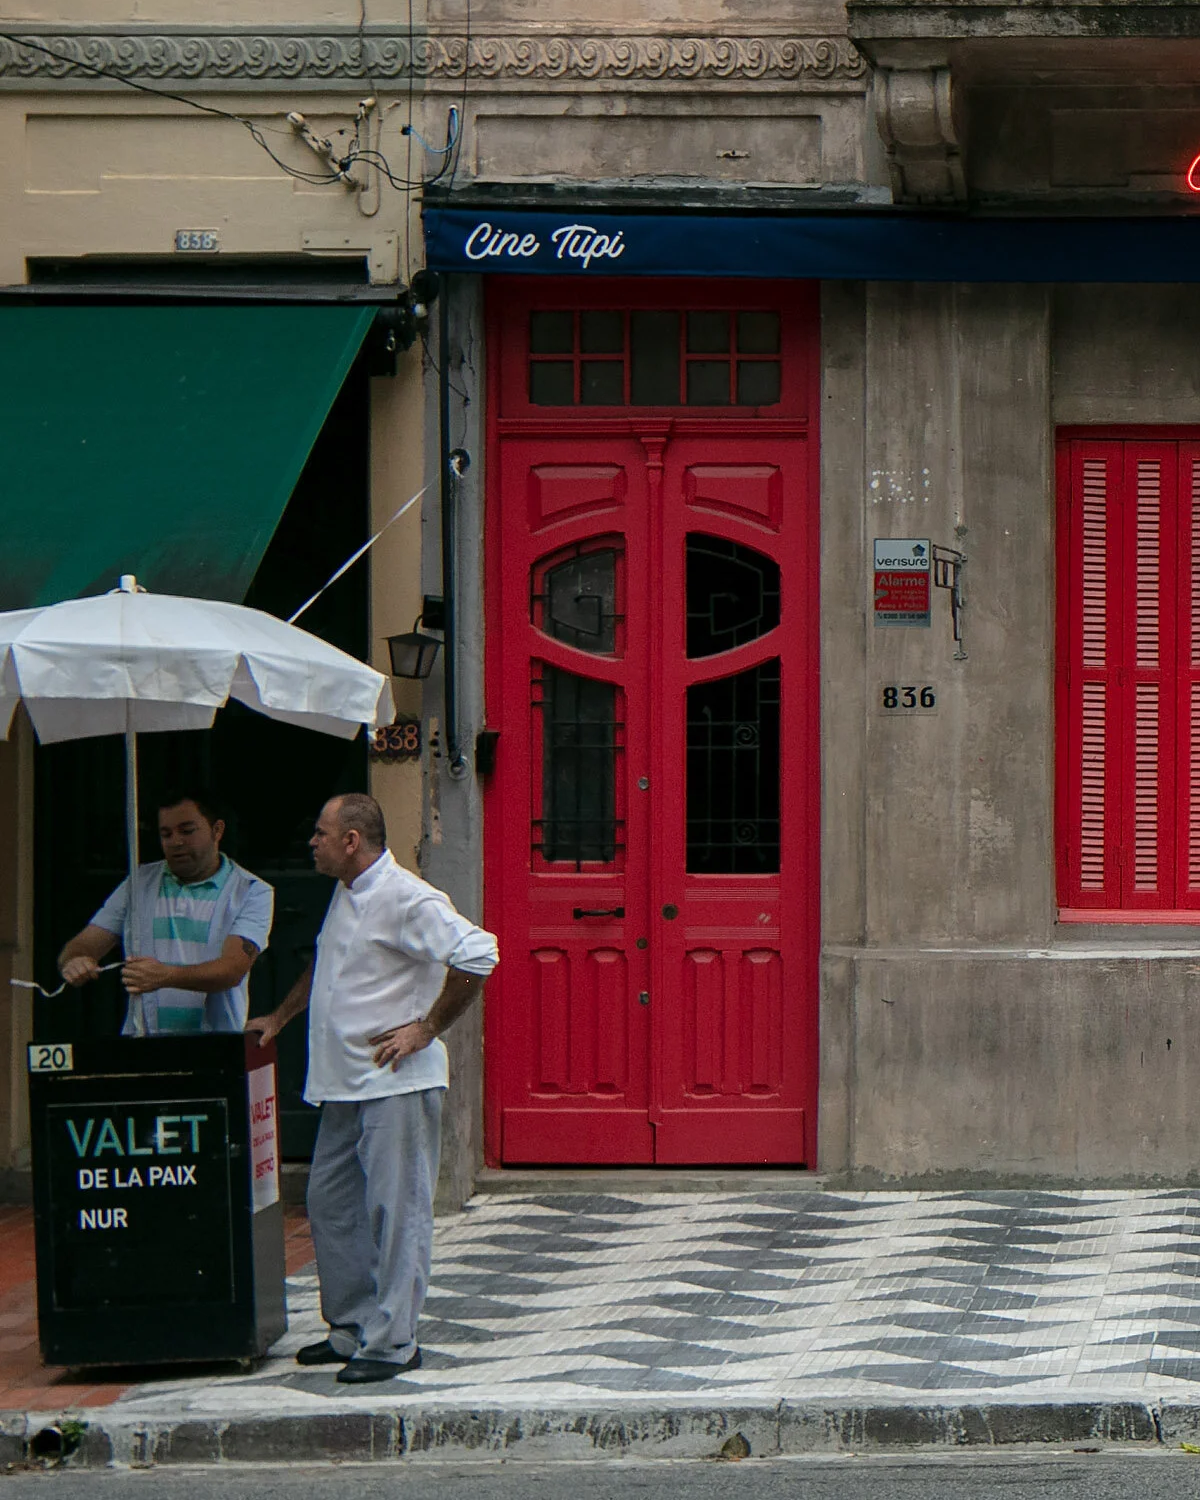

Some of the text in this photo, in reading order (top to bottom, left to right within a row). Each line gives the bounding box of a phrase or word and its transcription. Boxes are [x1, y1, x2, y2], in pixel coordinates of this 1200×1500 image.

[465, 222, 626, 269] Cine Tupi
[876, 557, 928, 567] verisure
[878, 573, 926, 587] Alarme
[883, 686, 936, 709] 836
[373, 724, 418, 752] 838
[38, 1047, 66, 1069] 20
[65, 1113, 209, 1159] VALET
[79, 1164, 198, 1190] DE LA PAIX
[79, 1207, 129, 1230] NUR
